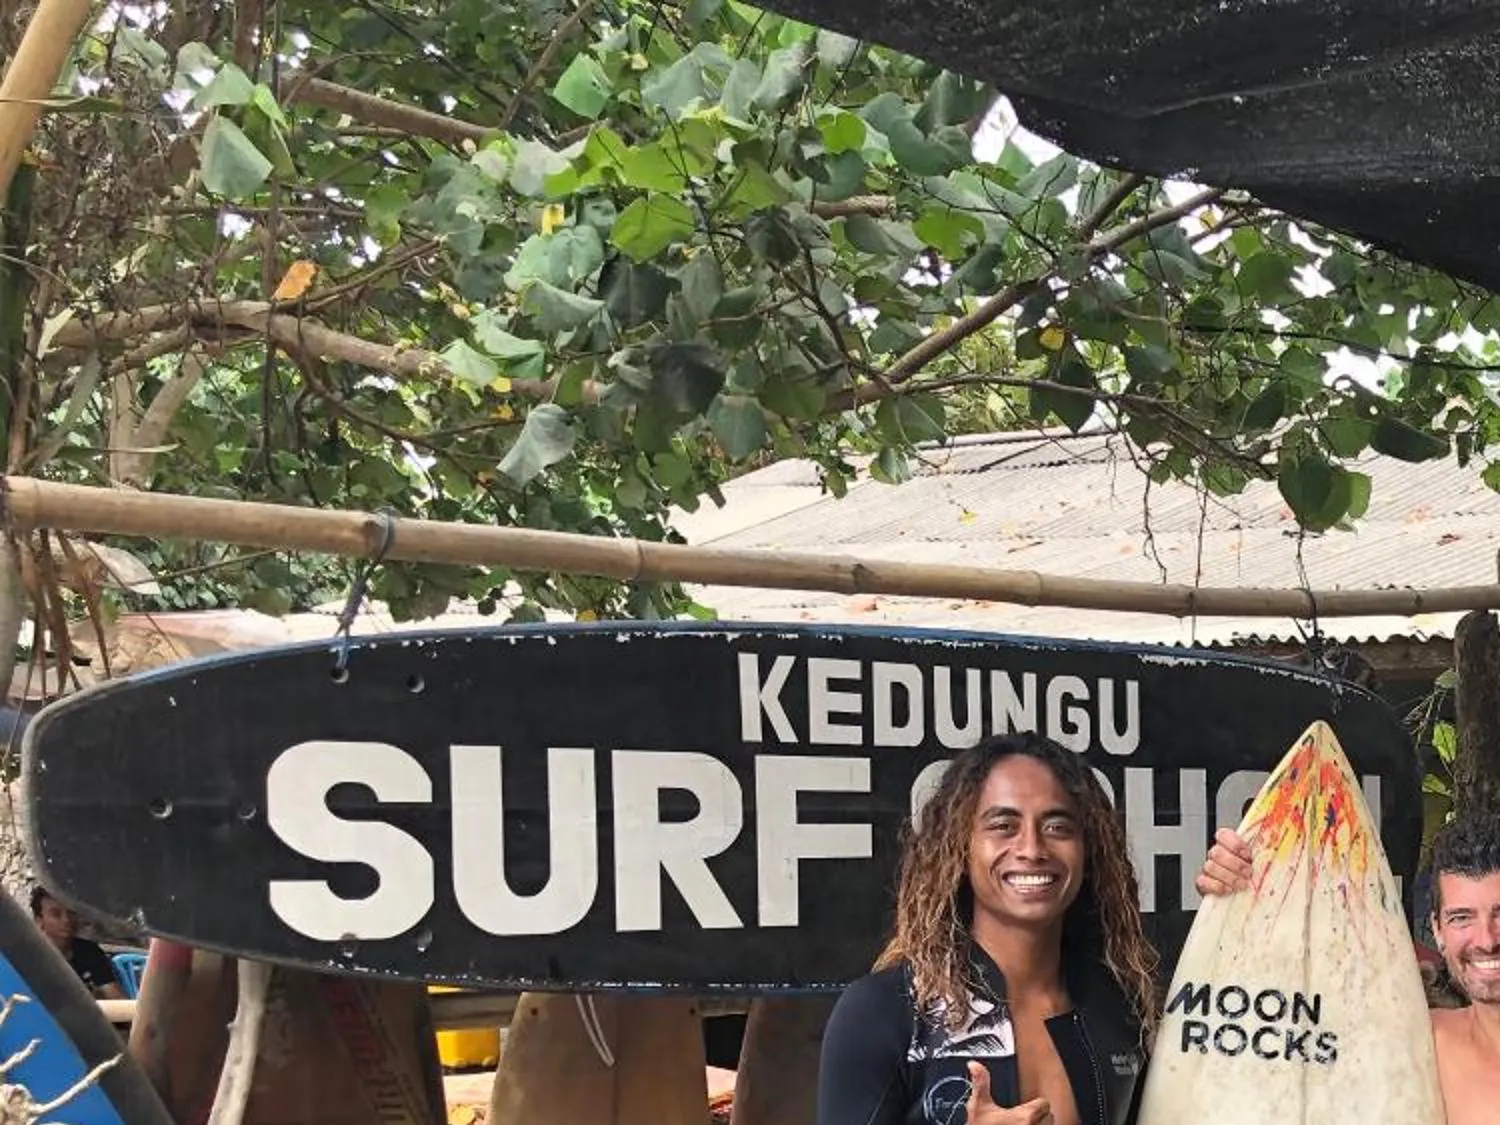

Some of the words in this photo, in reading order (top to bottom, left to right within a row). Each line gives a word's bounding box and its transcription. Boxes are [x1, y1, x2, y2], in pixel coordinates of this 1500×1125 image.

[737, 652, 1140, 756] KEDUNGU
[266, 740, 873, 942] SURF
[1165, 981, 1321, 1026] MOON
[1180, 1019, 1338, 1065] ROCKS
